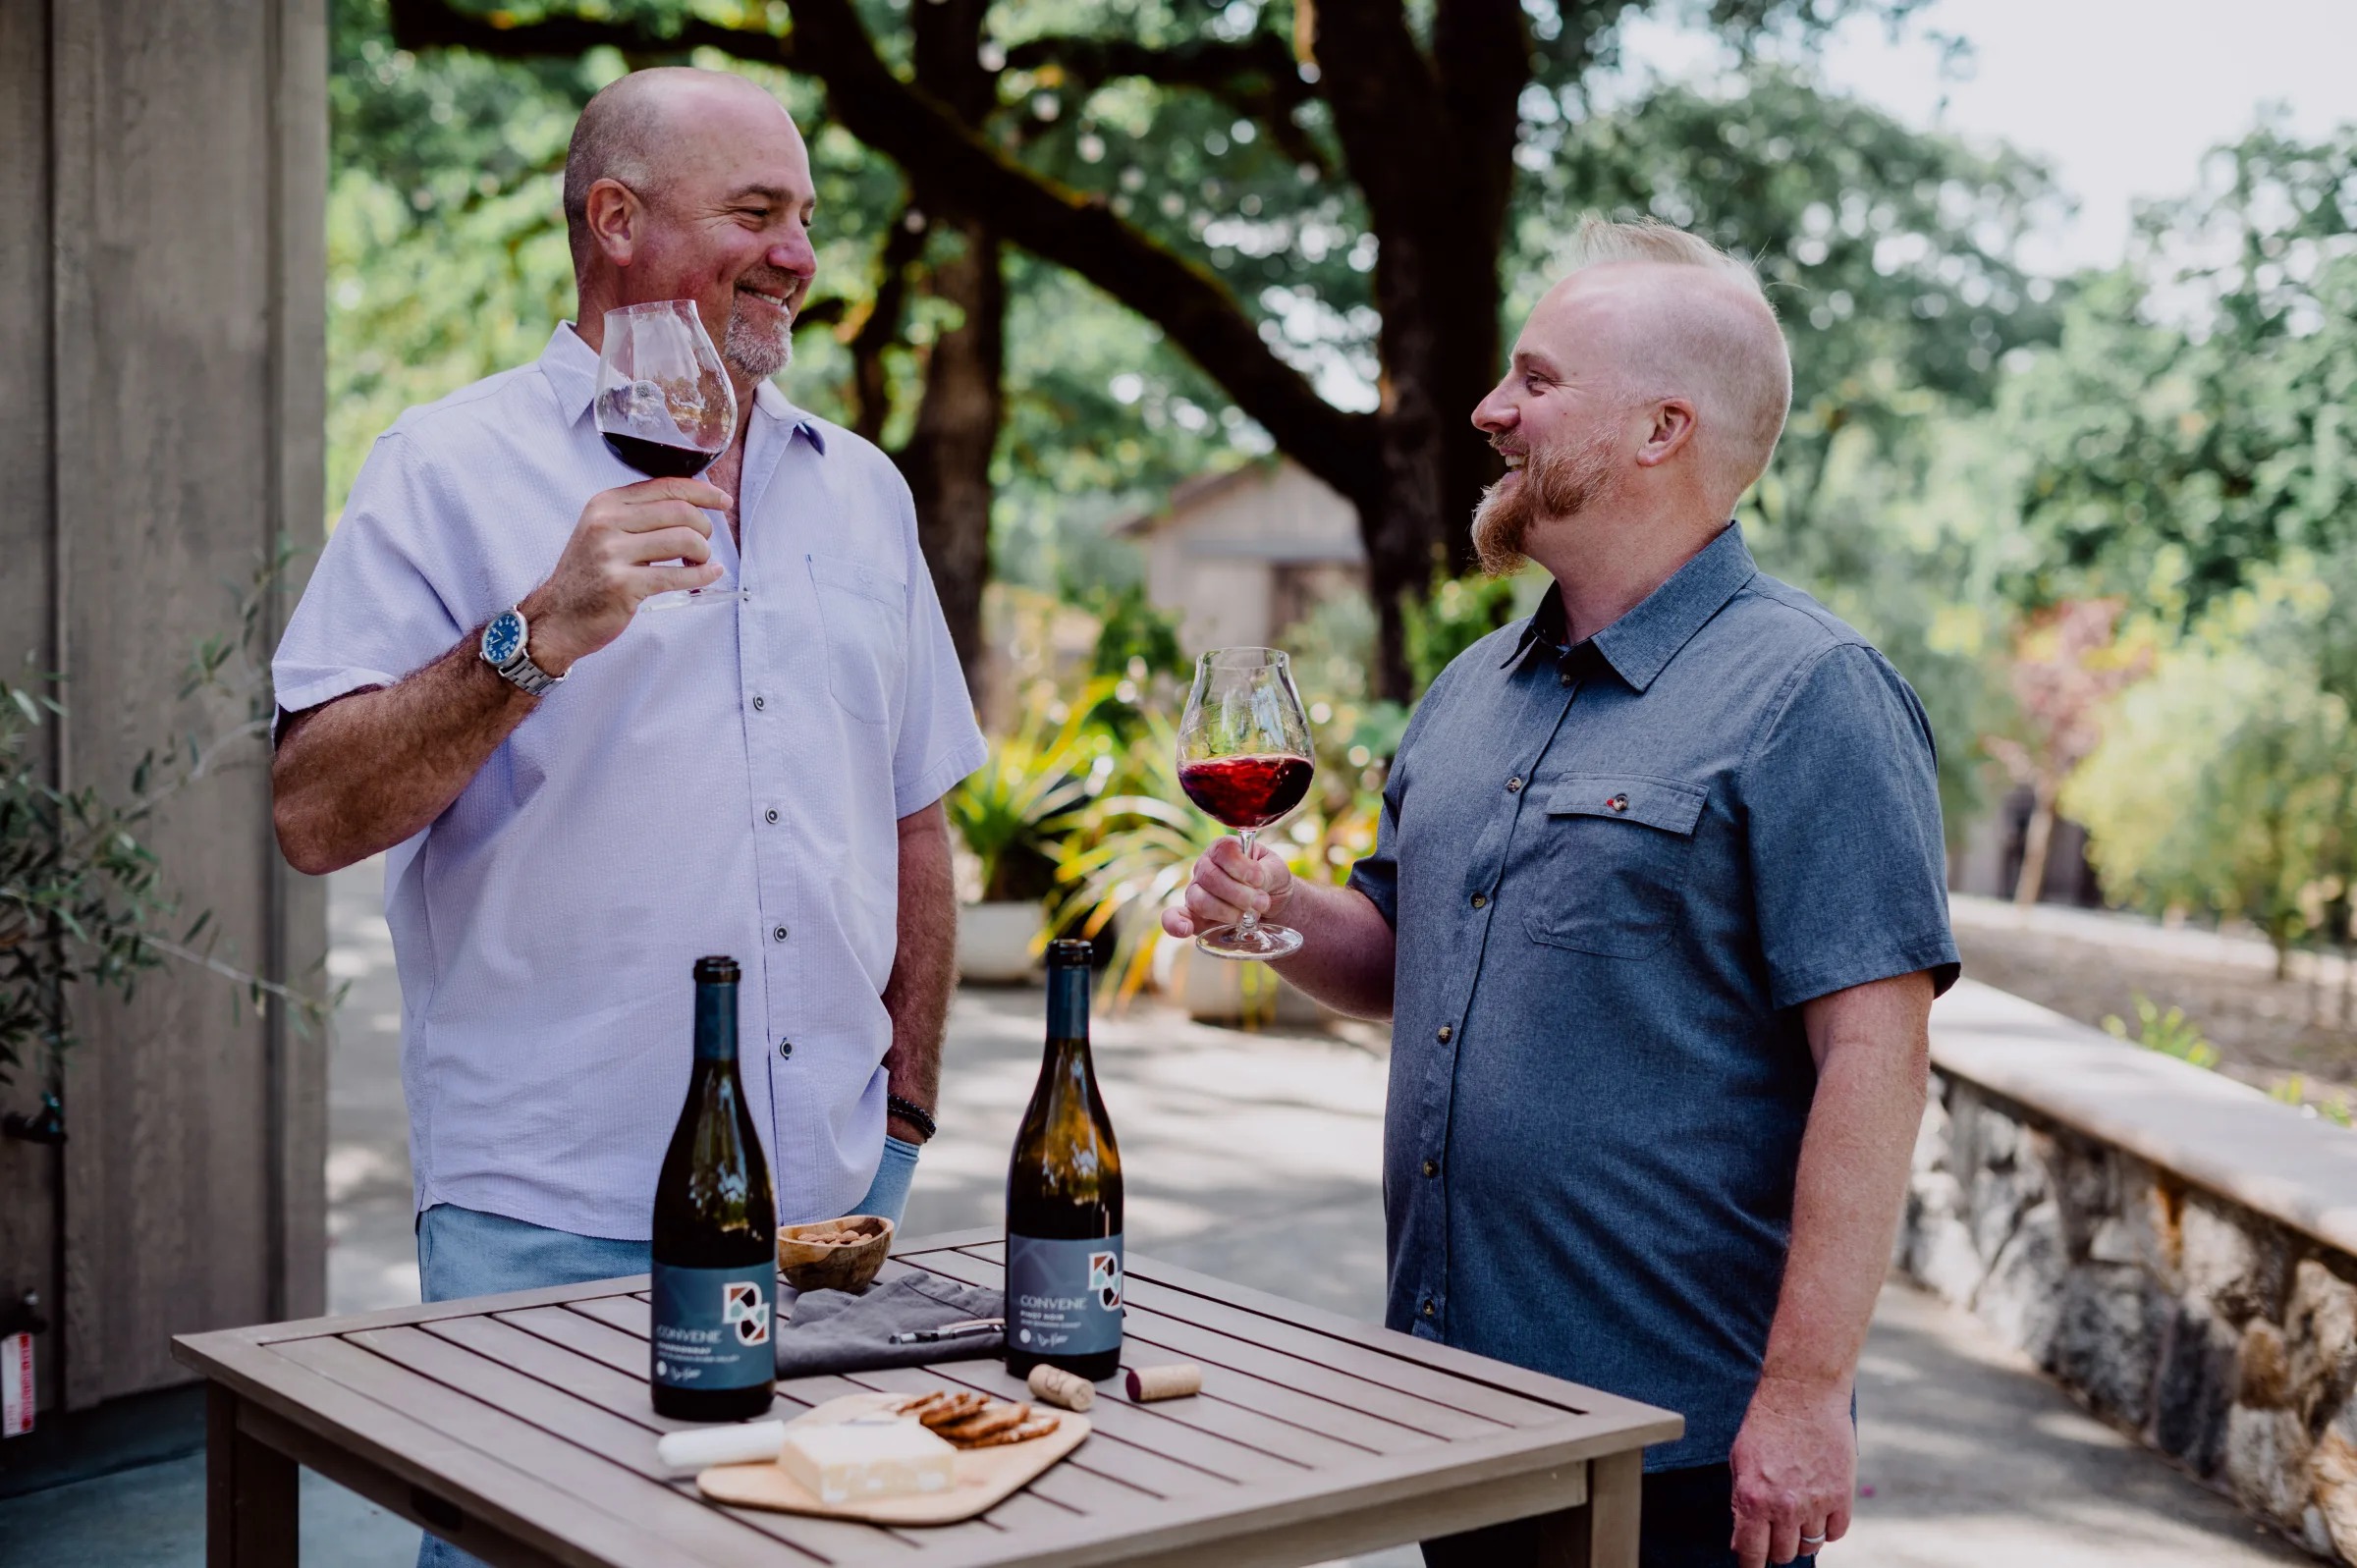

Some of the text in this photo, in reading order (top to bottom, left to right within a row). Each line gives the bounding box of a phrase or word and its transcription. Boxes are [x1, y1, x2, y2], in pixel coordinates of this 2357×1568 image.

[1019, 1294, 1087, 1311] CONVENE
[1043, 1313, 1065, 1322] NOIR
[657, 1325, 723, 1344] CONVENE
